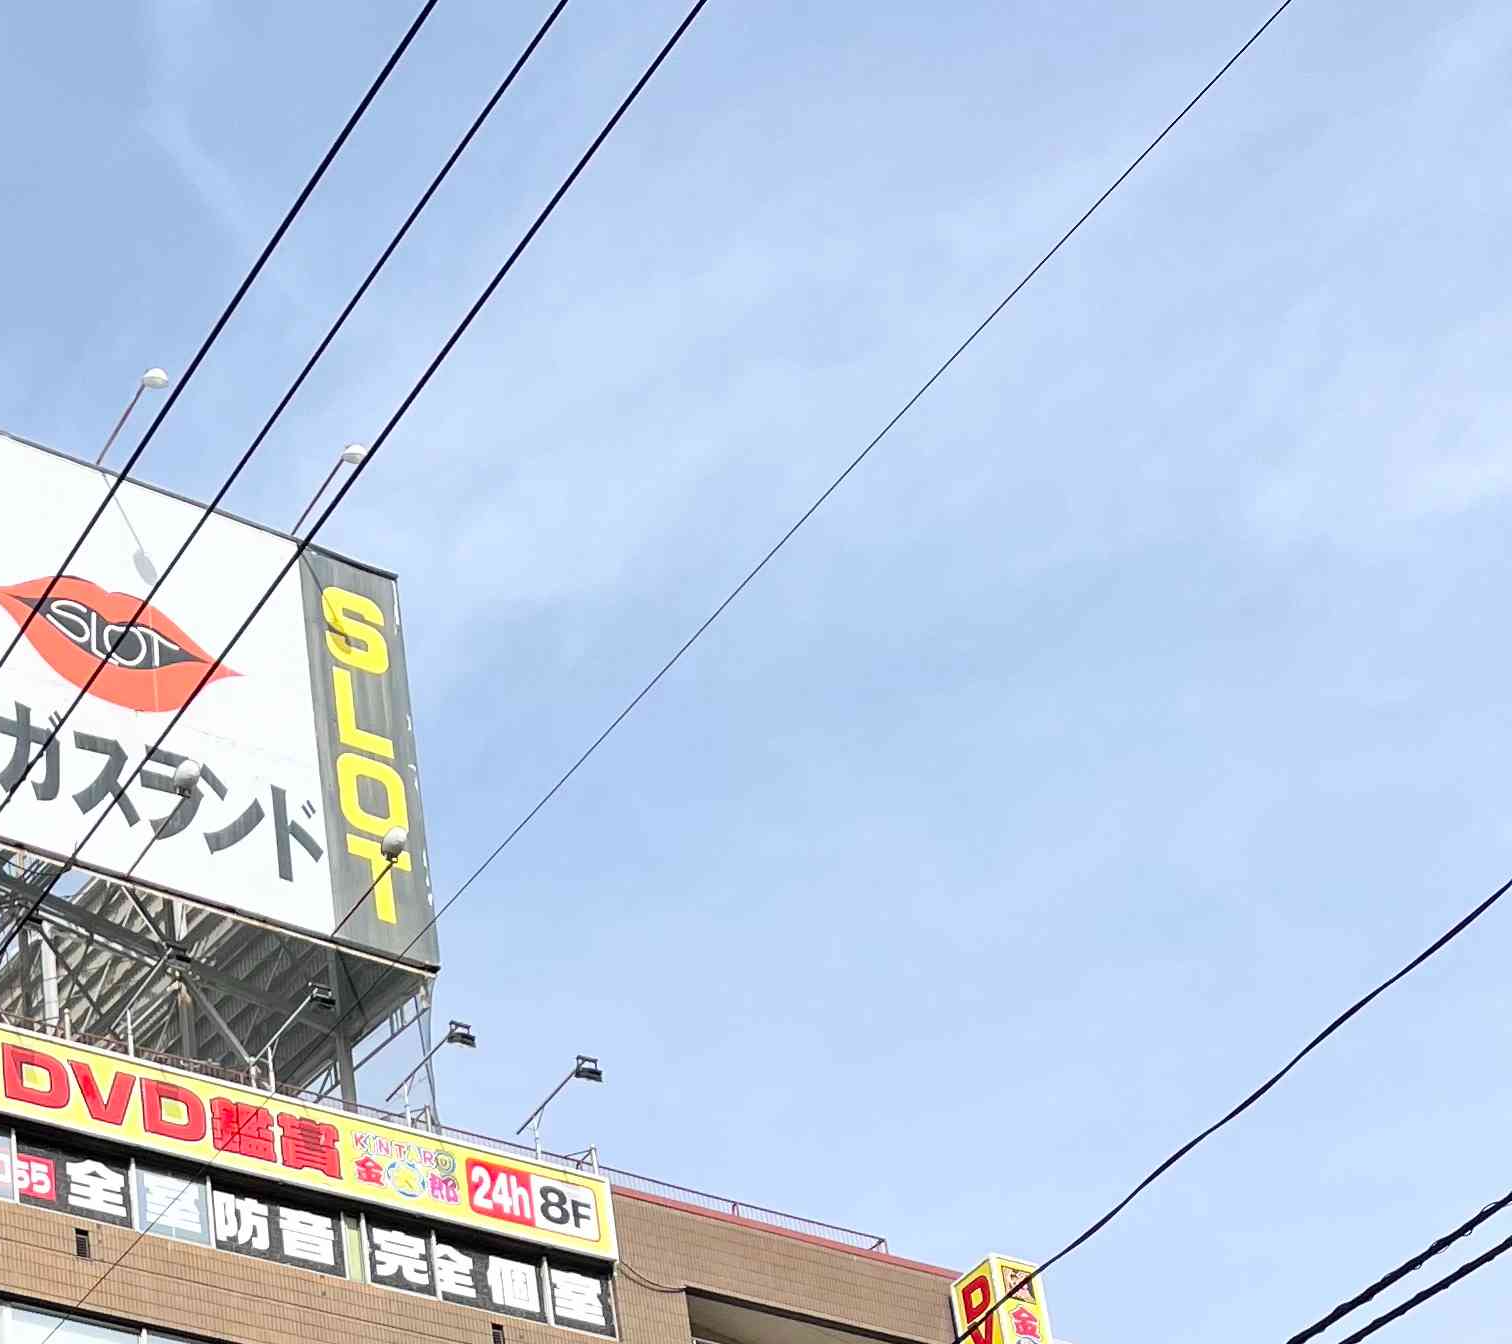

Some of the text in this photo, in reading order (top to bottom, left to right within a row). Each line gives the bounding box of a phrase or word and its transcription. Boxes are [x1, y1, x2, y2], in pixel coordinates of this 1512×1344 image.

[44, 596, 180, 667] SLOT
[319, 584, 411, 926] SLOT
[351, 1130, 457, 1173] KINTARO
[468, 1162, 535, 1221] 24h
[539, 1185, 592, 1229] 8F
